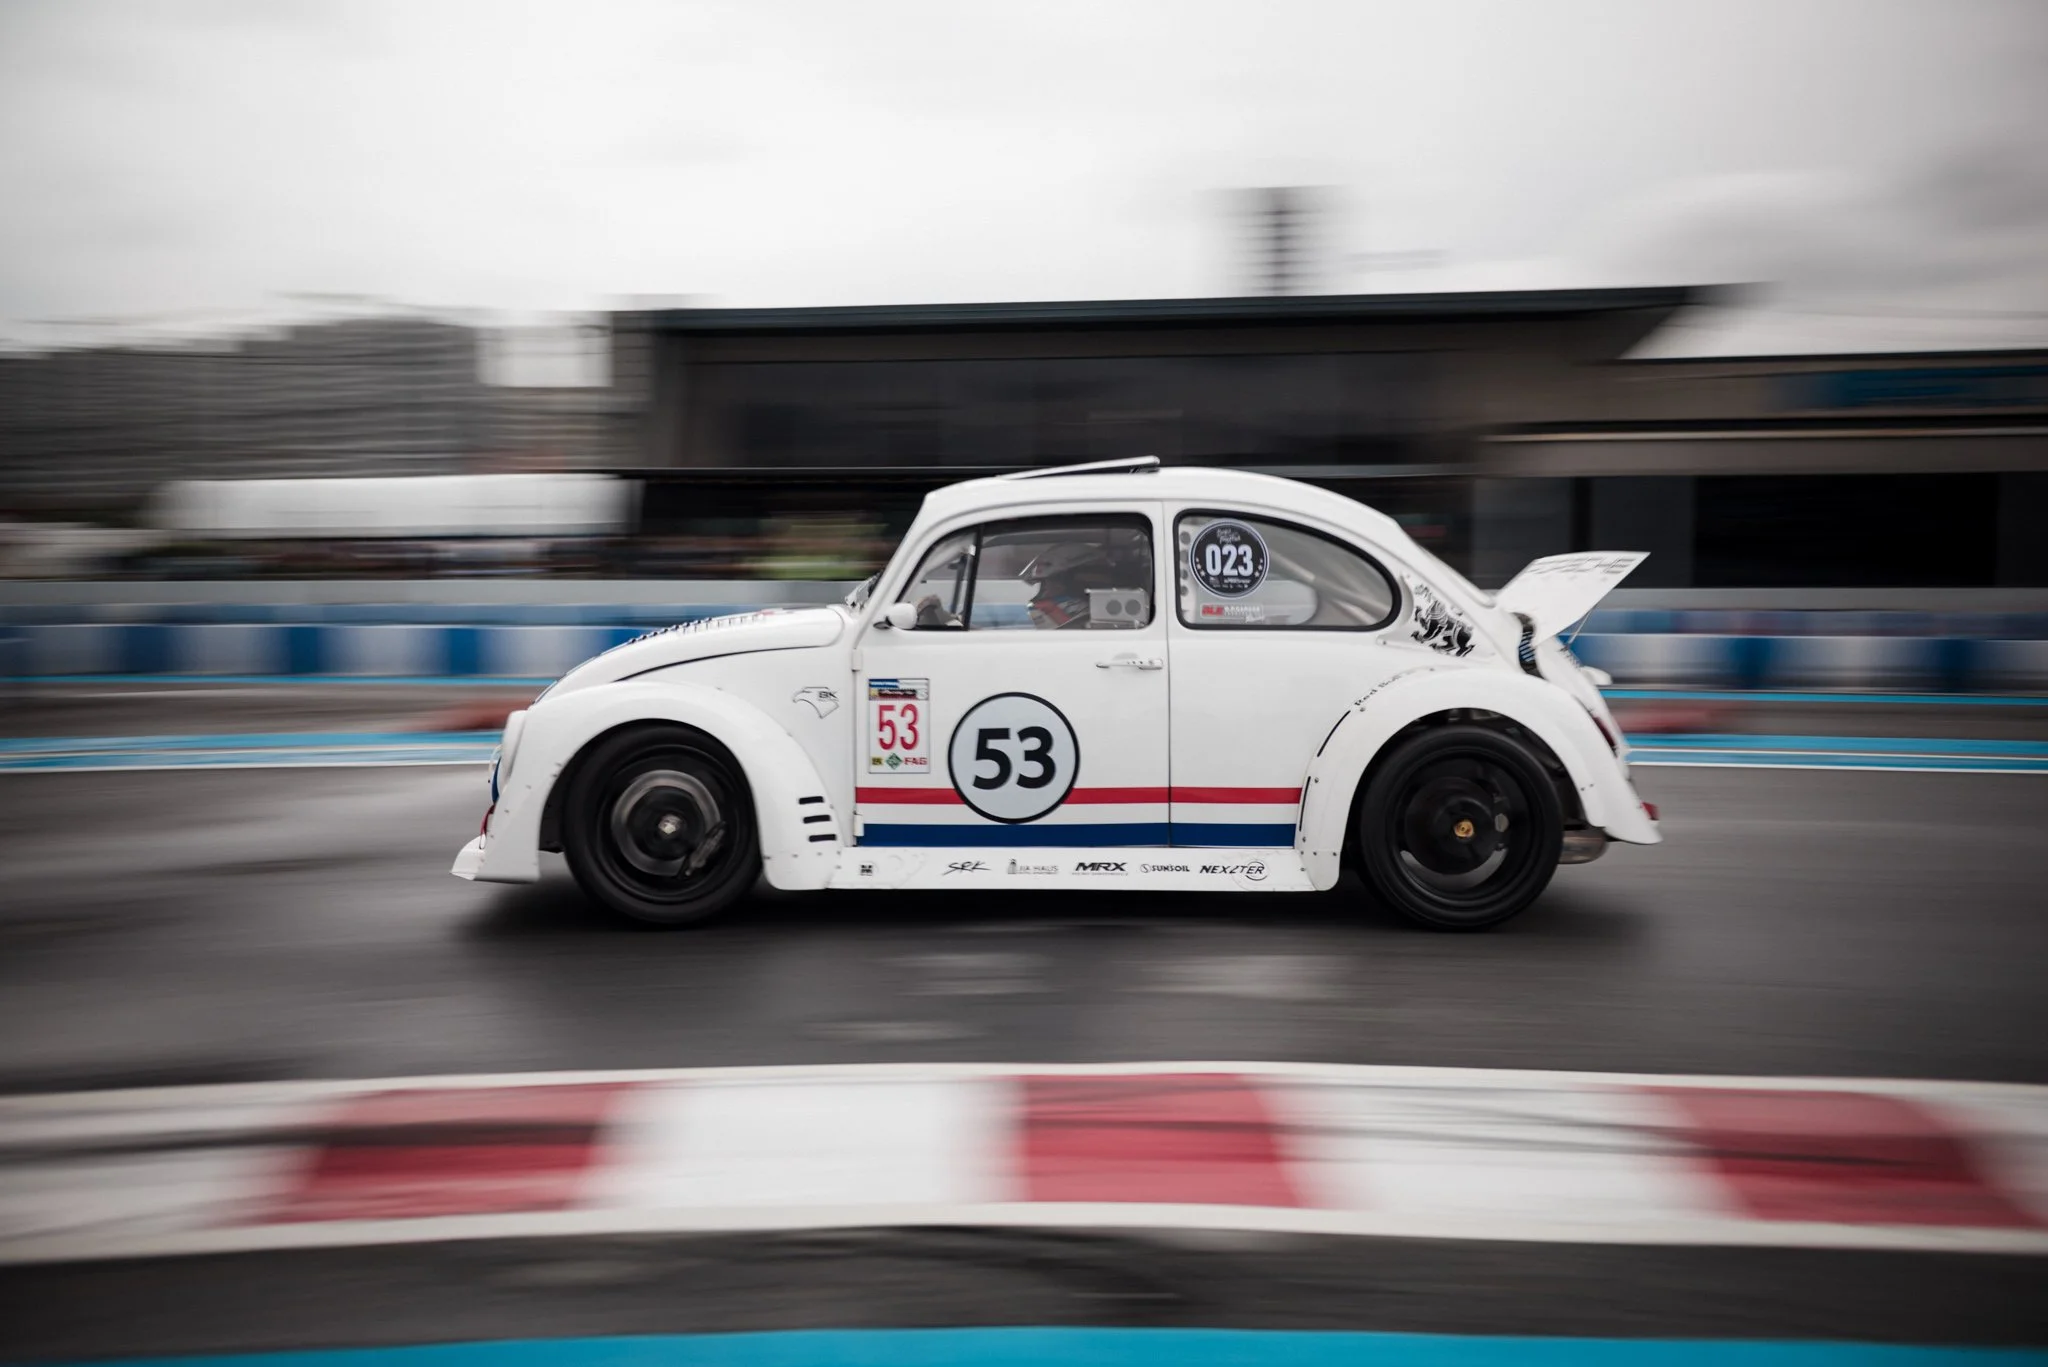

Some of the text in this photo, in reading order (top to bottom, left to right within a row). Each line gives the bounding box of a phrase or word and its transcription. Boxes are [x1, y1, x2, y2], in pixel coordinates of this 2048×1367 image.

[1205, 543, 1254, 577] 023
[878, 703, 919, 751] 53
[973, 726, 1056, 790] 53
[1076, 862, 1127, 871] MRX
